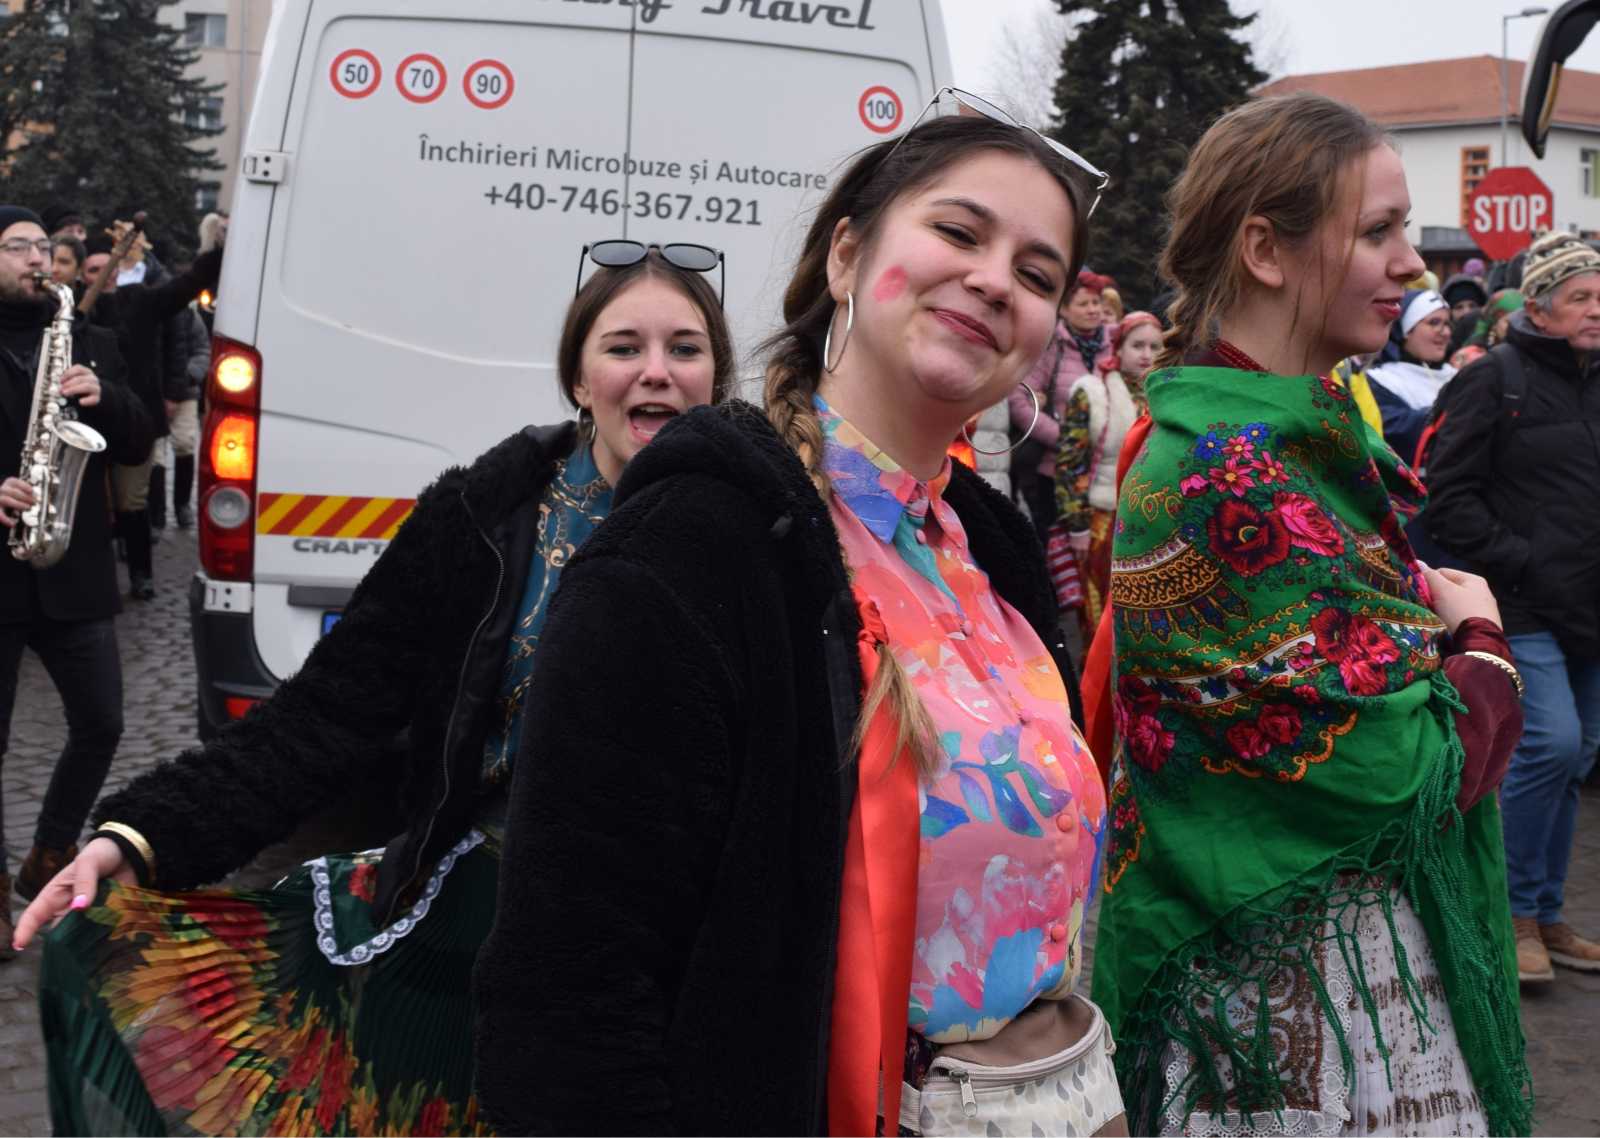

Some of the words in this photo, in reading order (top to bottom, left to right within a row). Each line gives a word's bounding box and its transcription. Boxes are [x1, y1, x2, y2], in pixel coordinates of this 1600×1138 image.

[344, 63, 369, 85] 50
[409, 67, 435, 89] 70
[476, 73, 502, 95] 90
[866, 99, 896, 120] 100
[419, 133, 537, 168] Închirieri
[546, 148, 682, 178] Microbuze
[689, 159, 709, 185] și
[715, 161, 828, 190] Autocare
[484, 182, 762, 226] +40-746-367.921
[1473, 193, 1548, 233] STOP
